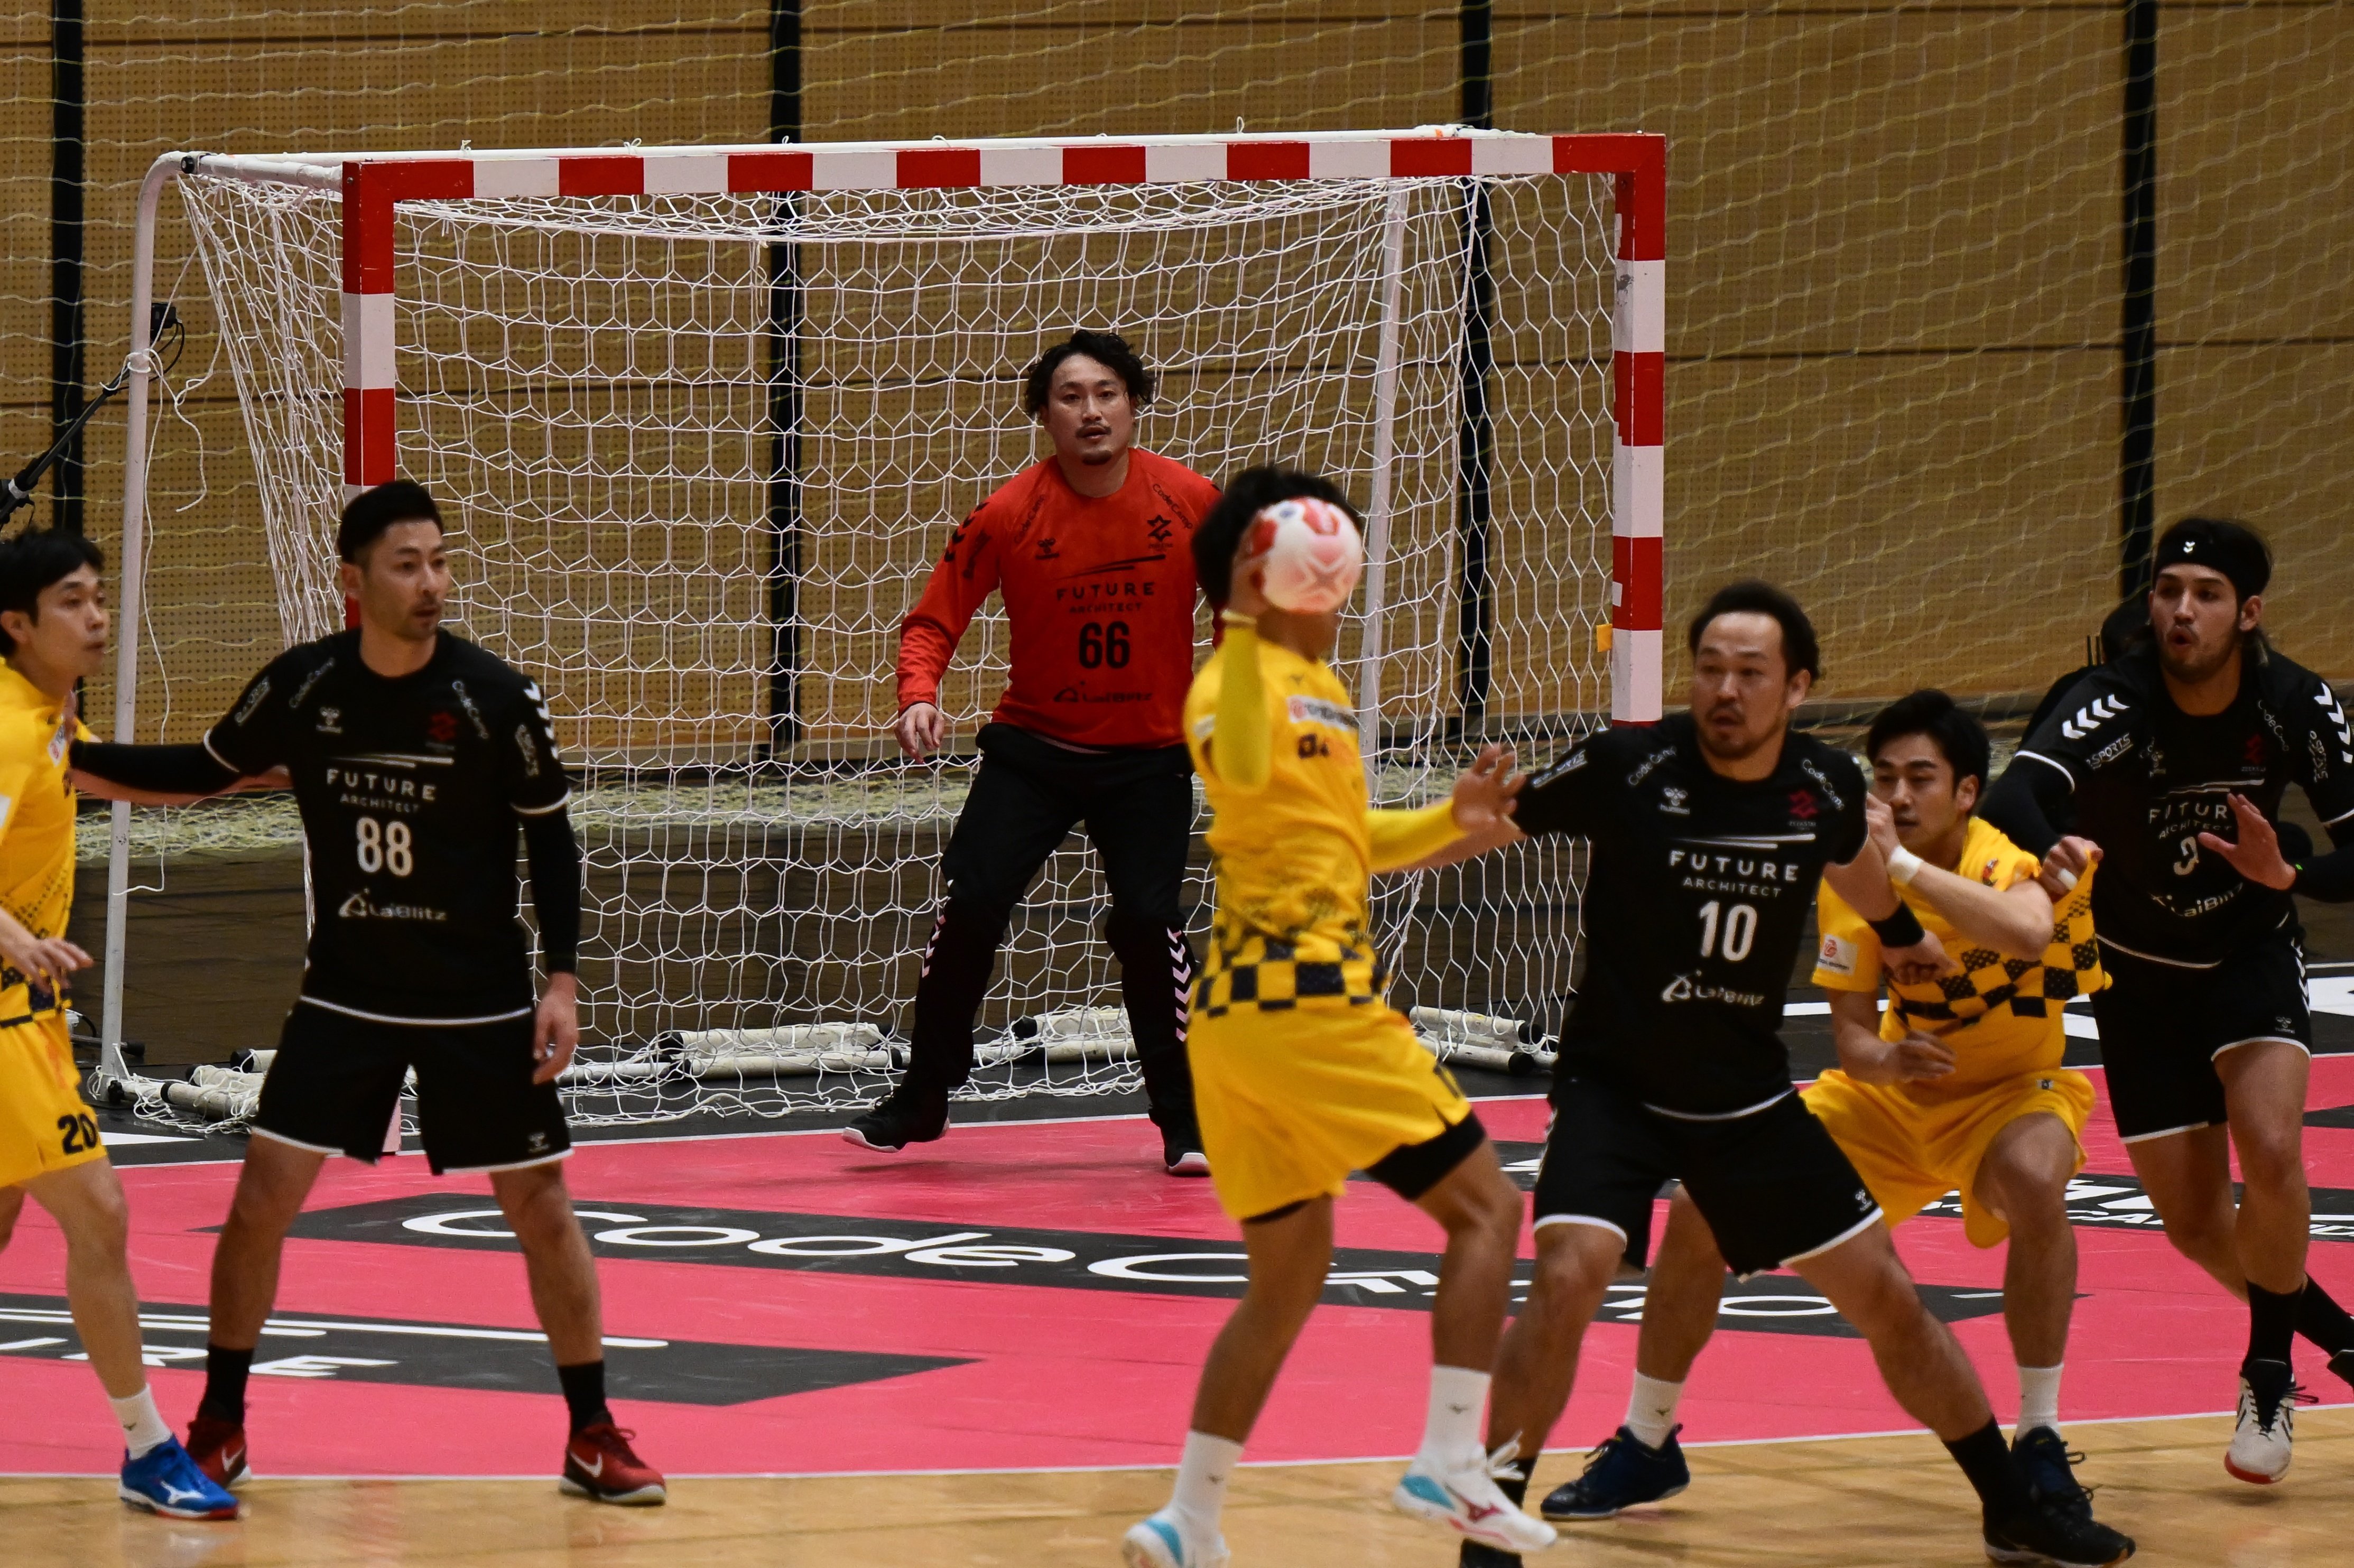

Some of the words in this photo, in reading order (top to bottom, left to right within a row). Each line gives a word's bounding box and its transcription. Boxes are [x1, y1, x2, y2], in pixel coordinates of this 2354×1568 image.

[1056, 582, 1155, 601] FUTURE
[1069, 602, 1142, 614] ARCHITECT
[1079, 621, 1130, 669] 66
[326, 768, 437, 802] FUTURE
[340, 793, 419, 813] ARCHITECT
[356, 817, 414, 877] 88
[1669, 849, 1799, 882] FUTURE
[1683, 877, 1782, 898] ARCHITECT
[1699, 899, 1758, 962] 10
[57, 1113, 98, 1155] 20
